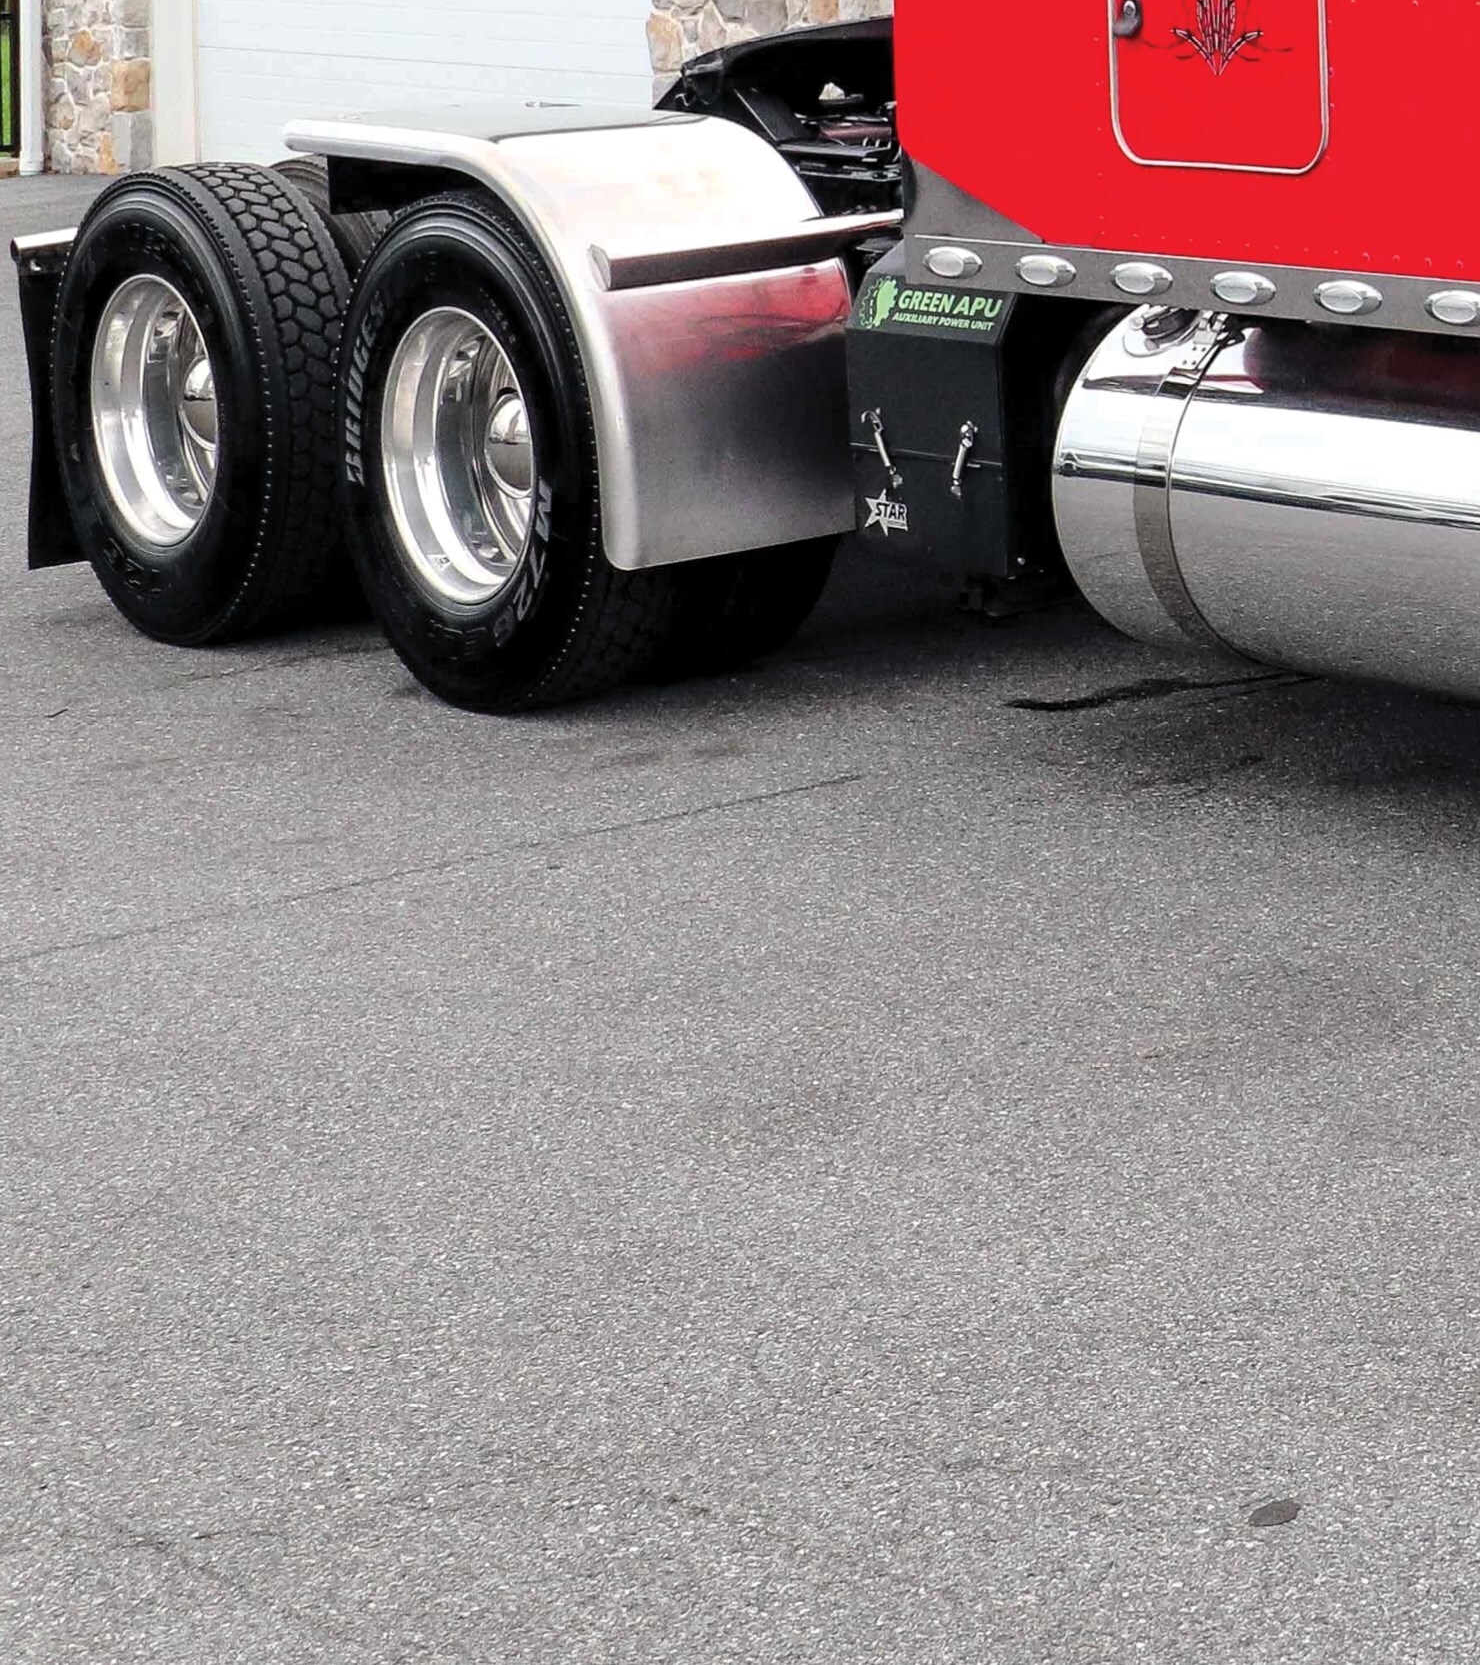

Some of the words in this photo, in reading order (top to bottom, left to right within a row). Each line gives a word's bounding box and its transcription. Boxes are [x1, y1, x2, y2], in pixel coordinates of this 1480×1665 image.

[898, 289, 956, 314] GREEN
[952, 295, 1003, 318] APU
[892, 311, 940, 326] AUXILIARY
[937, 316, 971, 329] POWER
[970, 321, 995, 332] UNIT
[875, 502, 906, 521] STAR
